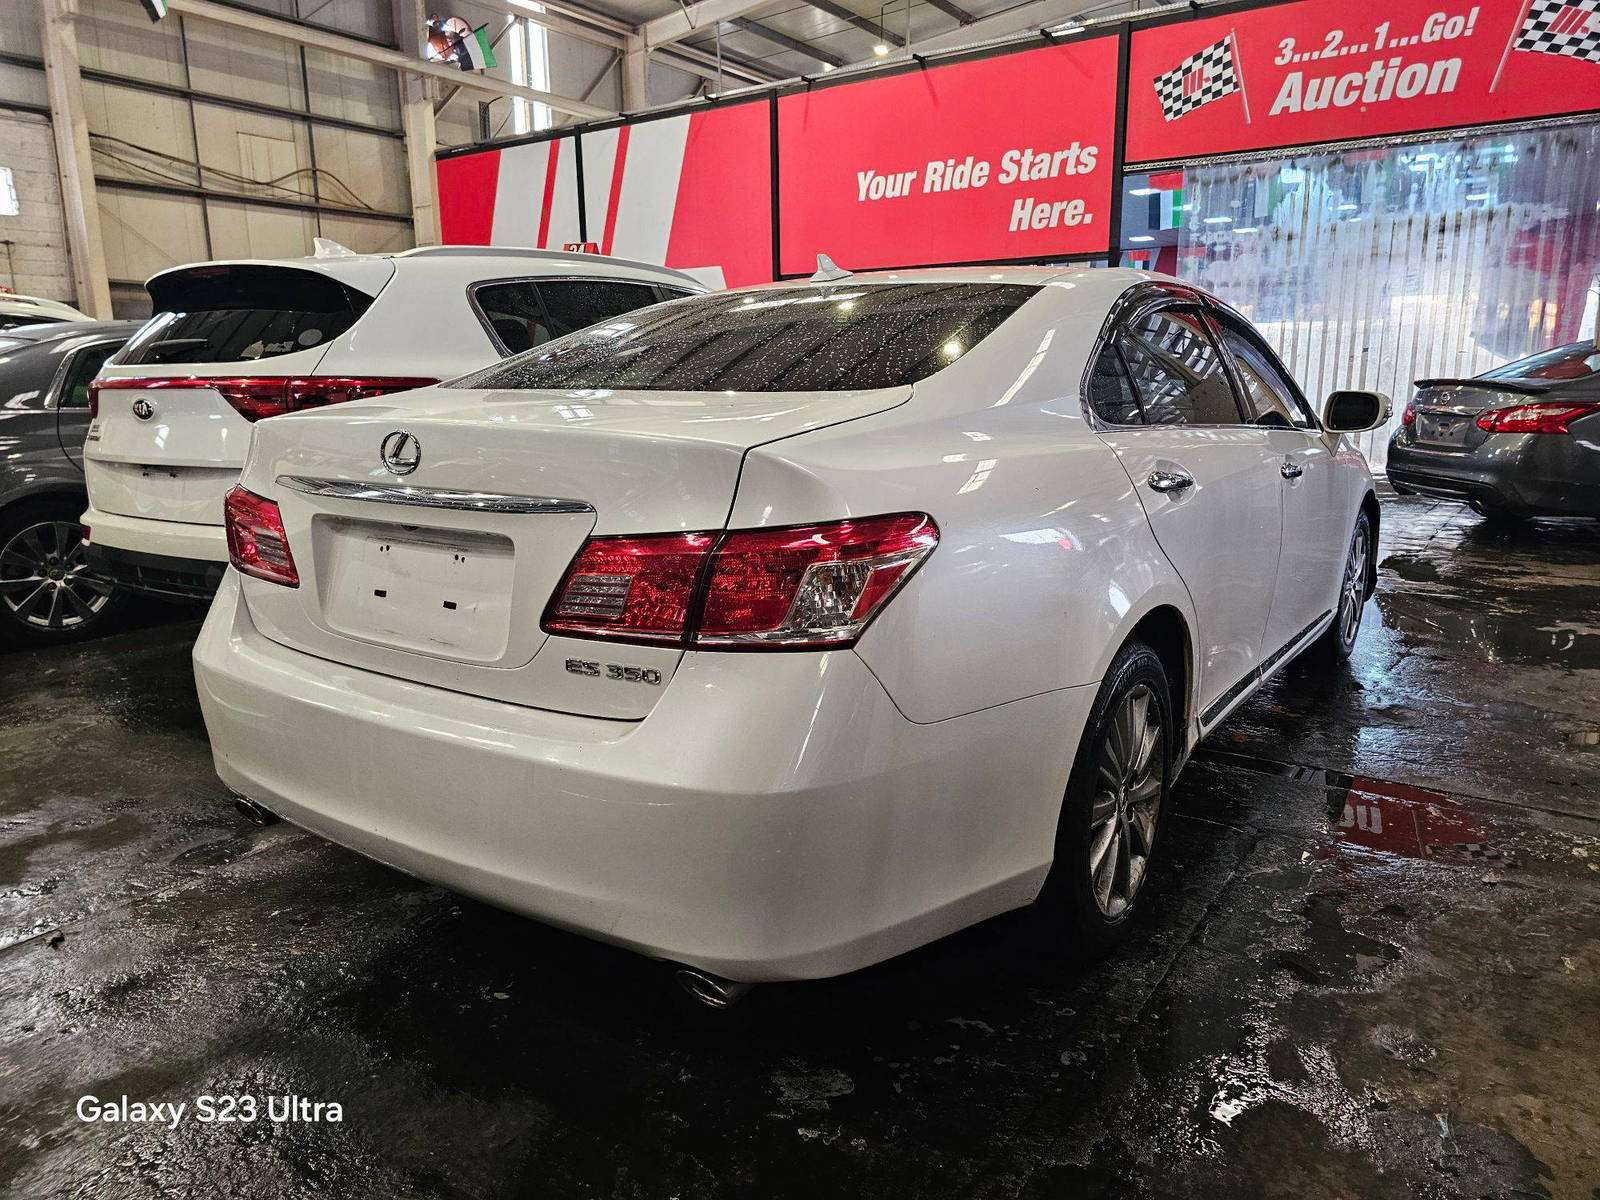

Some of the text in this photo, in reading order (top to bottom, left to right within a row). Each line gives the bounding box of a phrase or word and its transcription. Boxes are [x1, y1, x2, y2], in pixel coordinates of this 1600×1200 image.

[1268, 56, 1462, 116] Auction
[857, 141, 1098, 201] Your Ride Starts
[1008, 198, 1093, 231] Here.
[565, 658, 662, 685] ES 350
